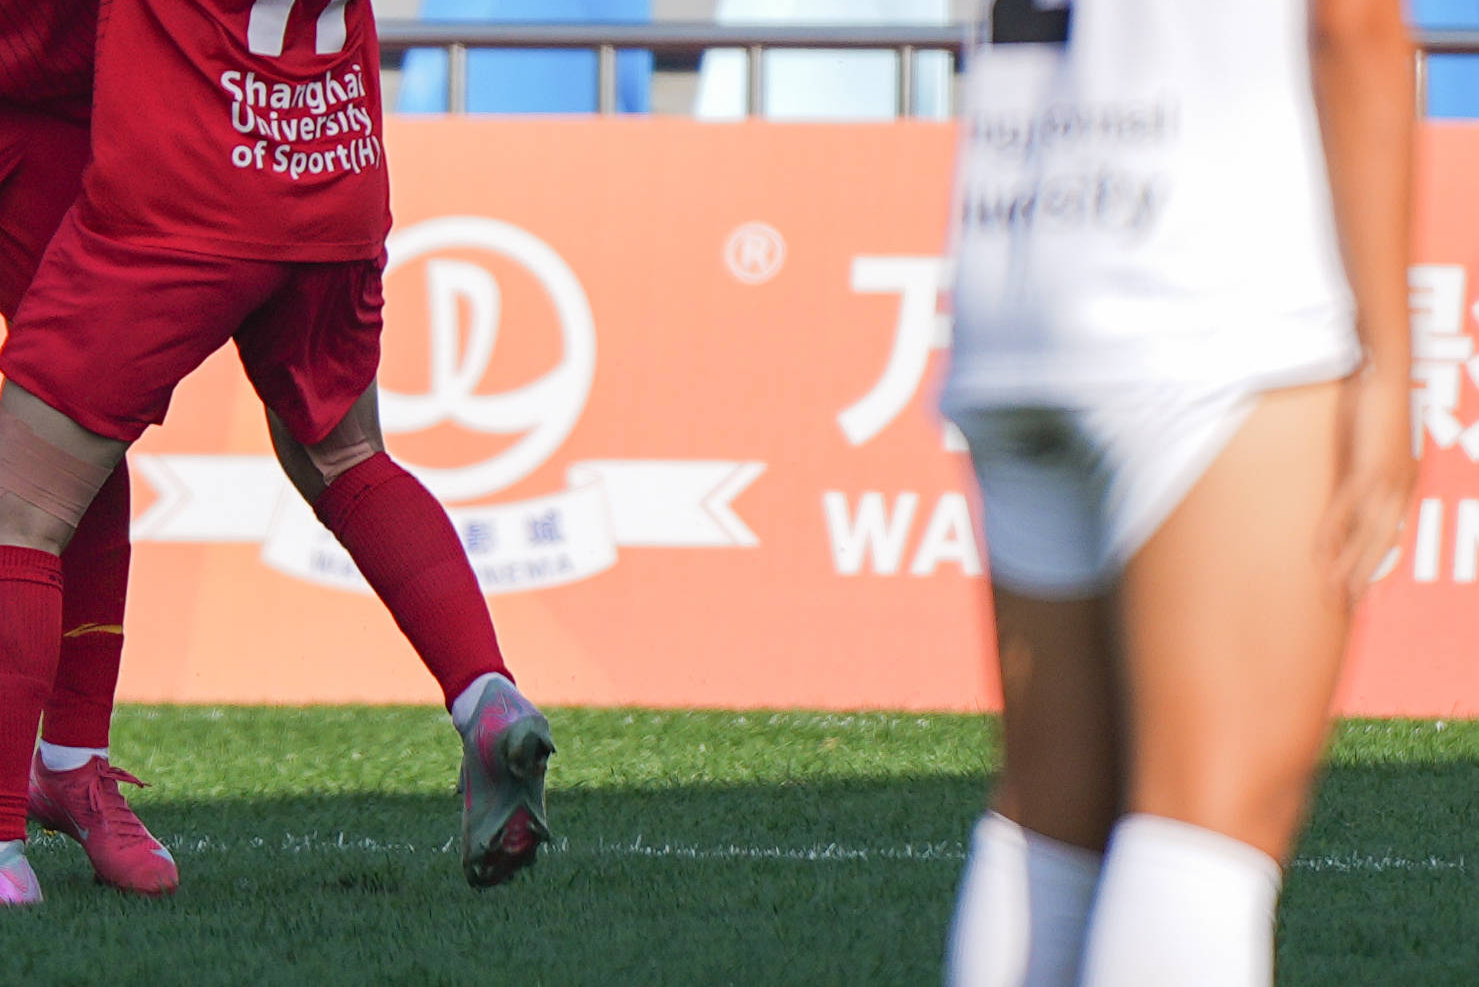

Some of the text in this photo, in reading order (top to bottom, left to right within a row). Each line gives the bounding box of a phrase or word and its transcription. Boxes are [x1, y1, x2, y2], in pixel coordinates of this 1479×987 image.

[220, 64, 366, 115] Shanghai
[231, 100, 372, 143] University
[231, 135, 382, 181] of Sport(H)
